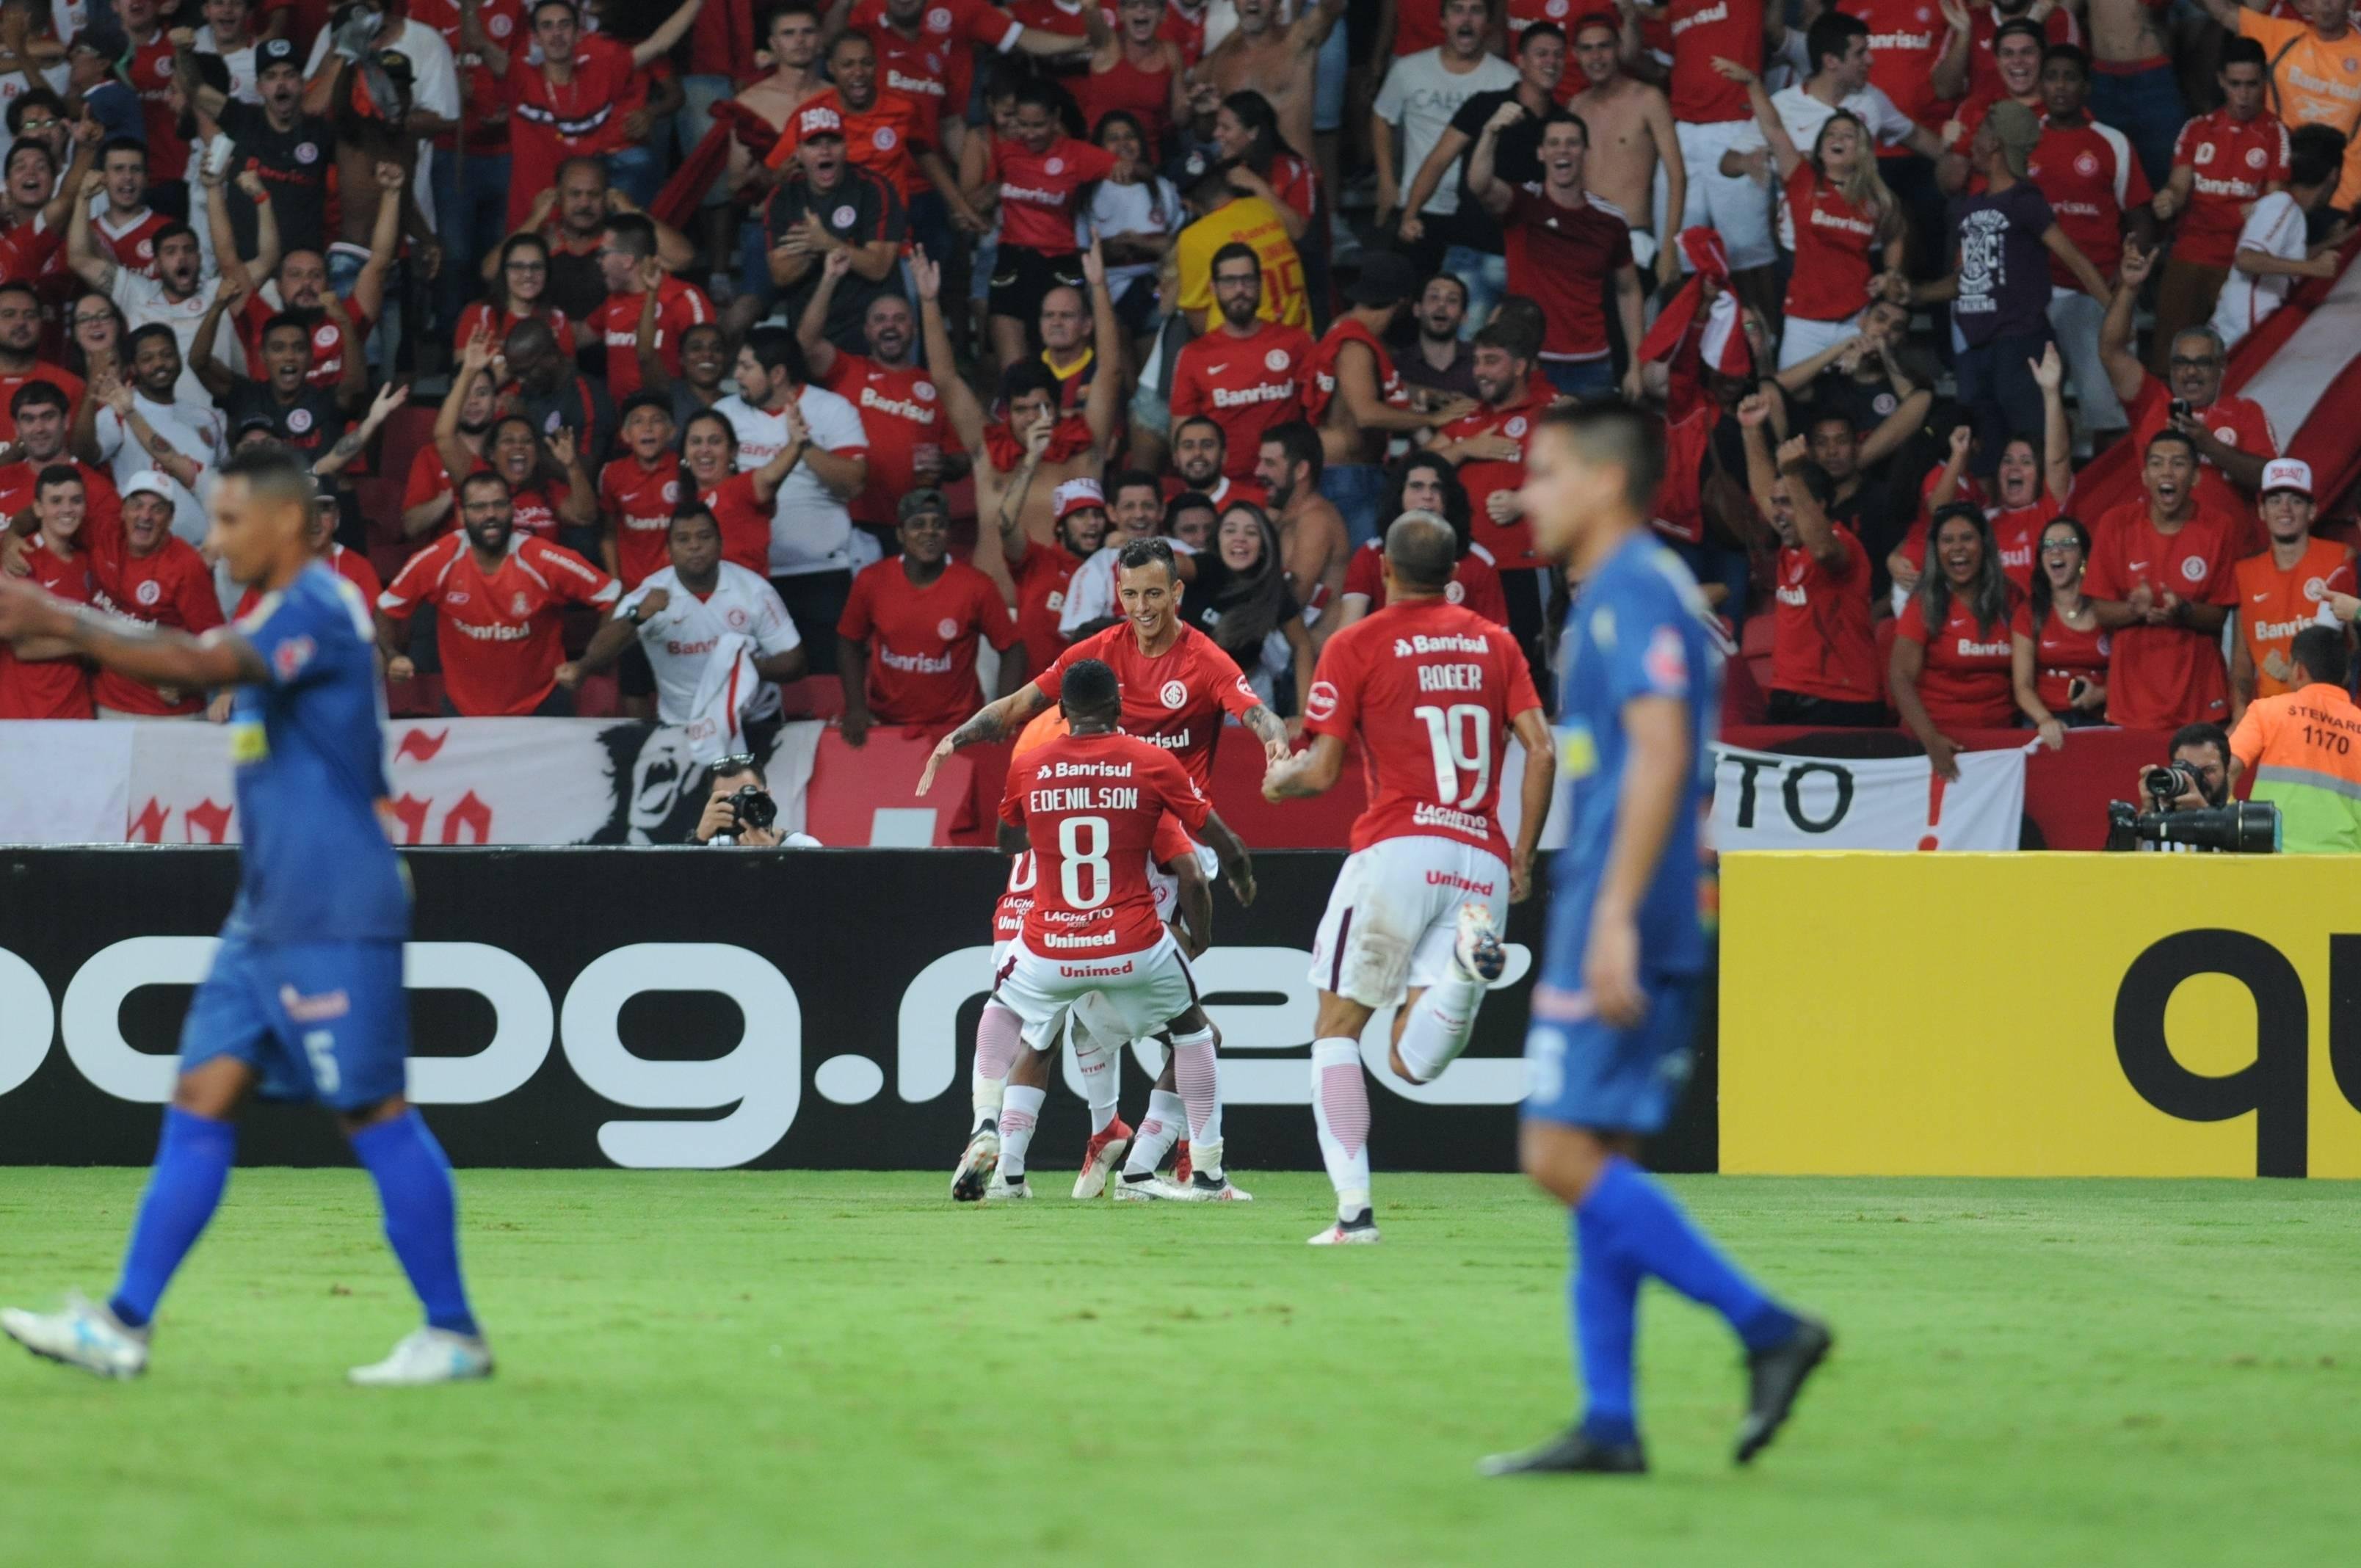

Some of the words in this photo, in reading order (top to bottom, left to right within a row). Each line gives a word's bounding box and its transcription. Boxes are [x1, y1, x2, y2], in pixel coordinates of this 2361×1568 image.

[860, 387, 935, 424] Banrisul
[1212, 379, 1294, 408] Banrisul
[1412, 633, 1489, 654] Banrisul
[1418, 664, 1481, 692] ROGER
[2303, 725, 2349, 755] 1170
[1414, 704, 1490, 808] 19
[1055, 761, 1132, 778] Banrisul
[1030, 787, 1138, 813] EDENILSON
[1059, 816, 1110, 910] 8
[1426, 870, 1494, 896] Unimed
[1044, 907, 1114, 922] LAGHETTO
[1044, 929, 1117, 948] Unimed
[1060, 960, 1134, 979] Unimed
